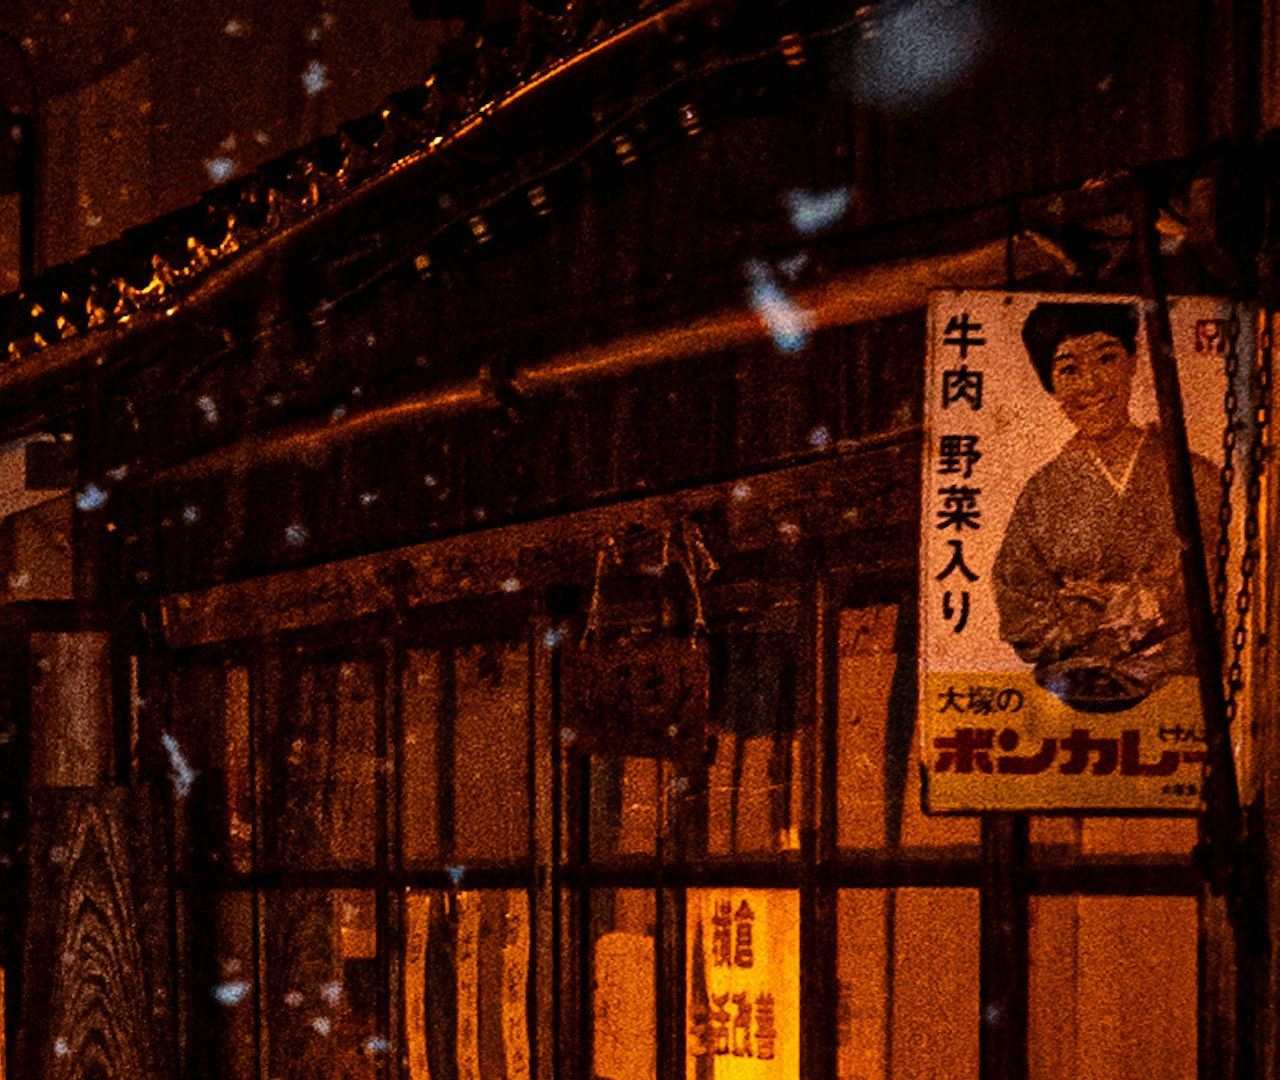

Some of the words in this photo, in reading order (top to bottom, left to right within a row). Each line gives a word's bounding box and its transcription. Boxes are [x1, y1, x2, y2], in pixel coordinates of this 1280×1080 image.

[943, 313, 987, 411] 牛肉
[936, 434, 982, 634] 野菜入り
[938, 686, 1024, 715] 大塚の
[934, 728, 1207, 776] ボンカレー
